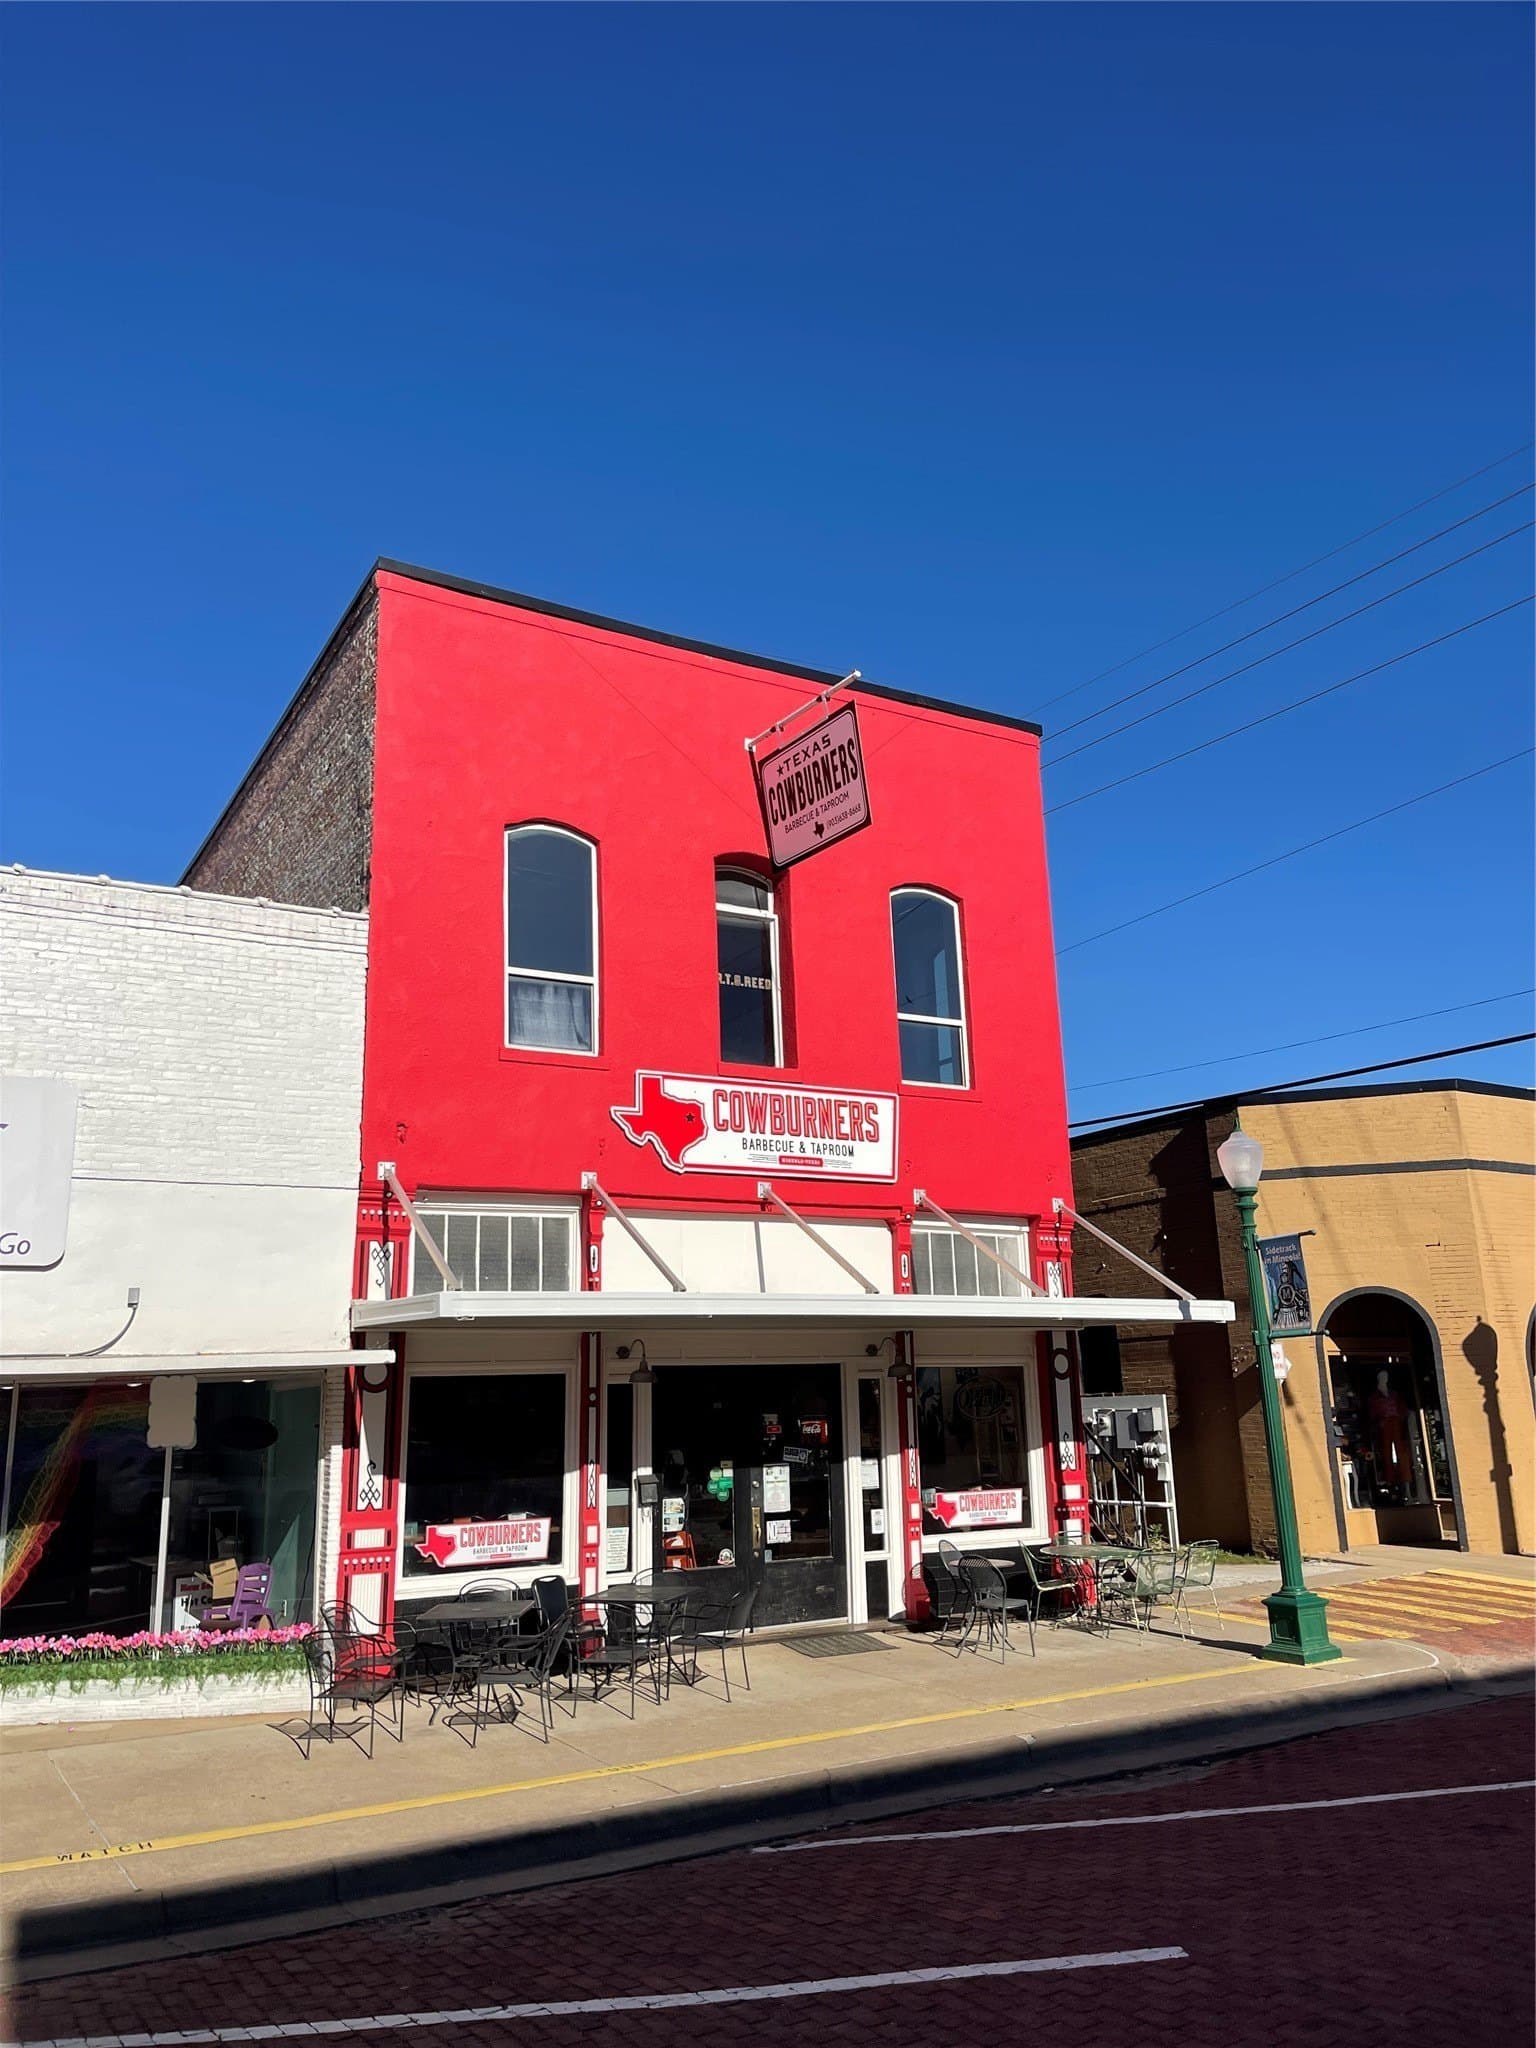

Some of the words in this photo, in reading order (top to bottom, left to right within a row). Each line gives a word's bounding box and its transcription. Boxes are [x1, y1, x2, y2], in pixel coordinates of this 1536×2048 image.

[783, 733, 831, 772] TEXAS
[768, 737, 858, 826] COWBURNERS
[784, 809, 815, 834] BARBECUE
[815, 807, 820, 818] &
[820, 790, 850, 813] TAPROOM
[713, 1089, 879, 1143] COWBURNERS
[742, 1137, 795, 1154] BARBECUE
[799, 1141, 806, 1154] &
[811, 1142, 855, 1157] TAPROOM
[959, 1491, 1017, 1512] COWBURNERS
[460, 1522, 541, 1548] COWBURNERS
[57, 1842, 152, 1861] WATCH
